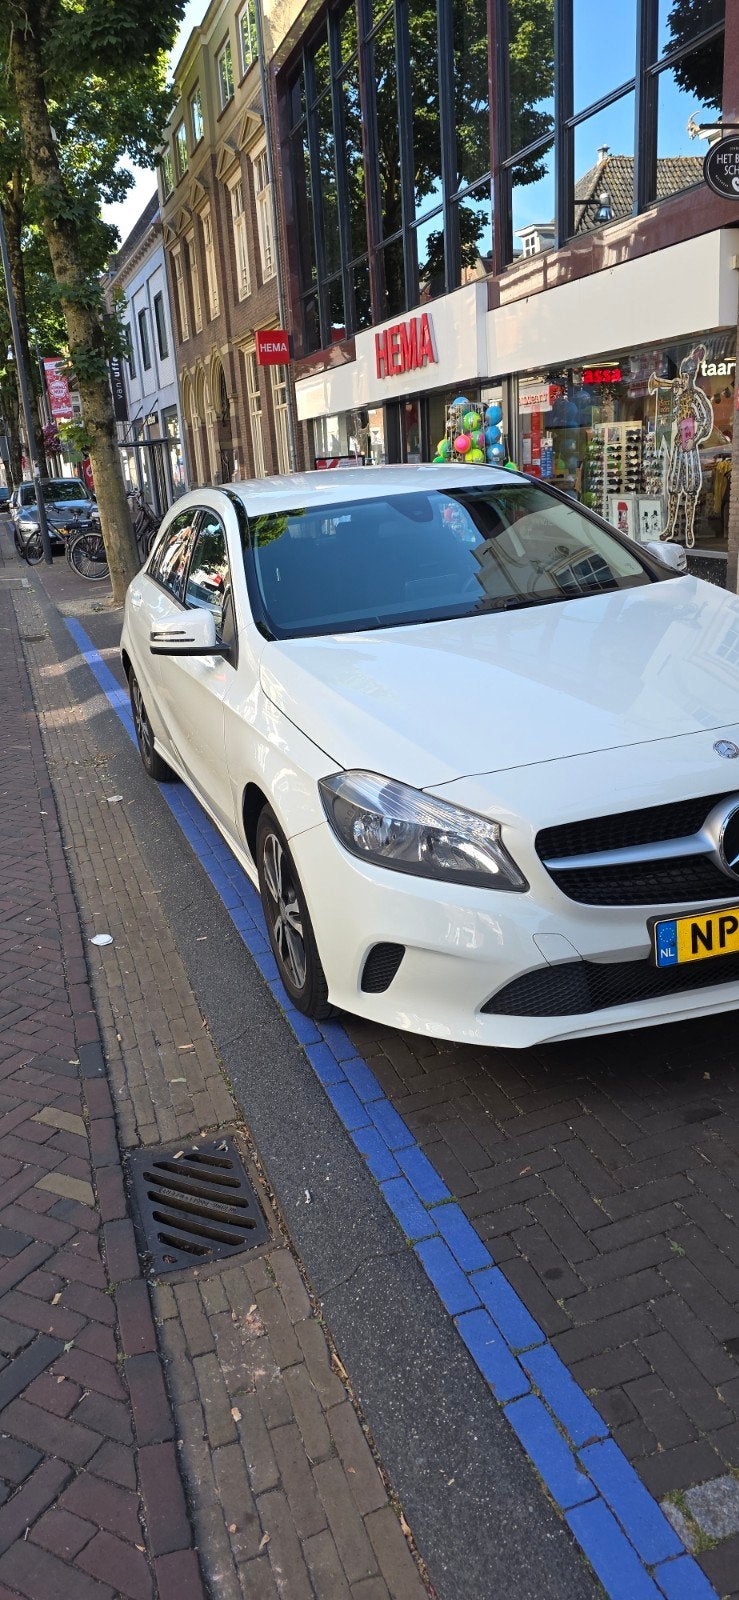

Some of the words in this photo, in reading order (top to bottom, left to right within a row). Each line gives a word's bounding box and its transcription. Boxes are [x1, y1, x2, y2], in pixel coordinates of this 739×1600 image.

[716, 153, 733, 164] HET
[260, 343, 287, 353] HEMA
[375, 313, 437, 379] HEMA
[582, 368, 622, 384] assa
[701, 360, 736, 377] taar
[660, 948, 675, 959] NL
[691, 915, 739, 954] NP
